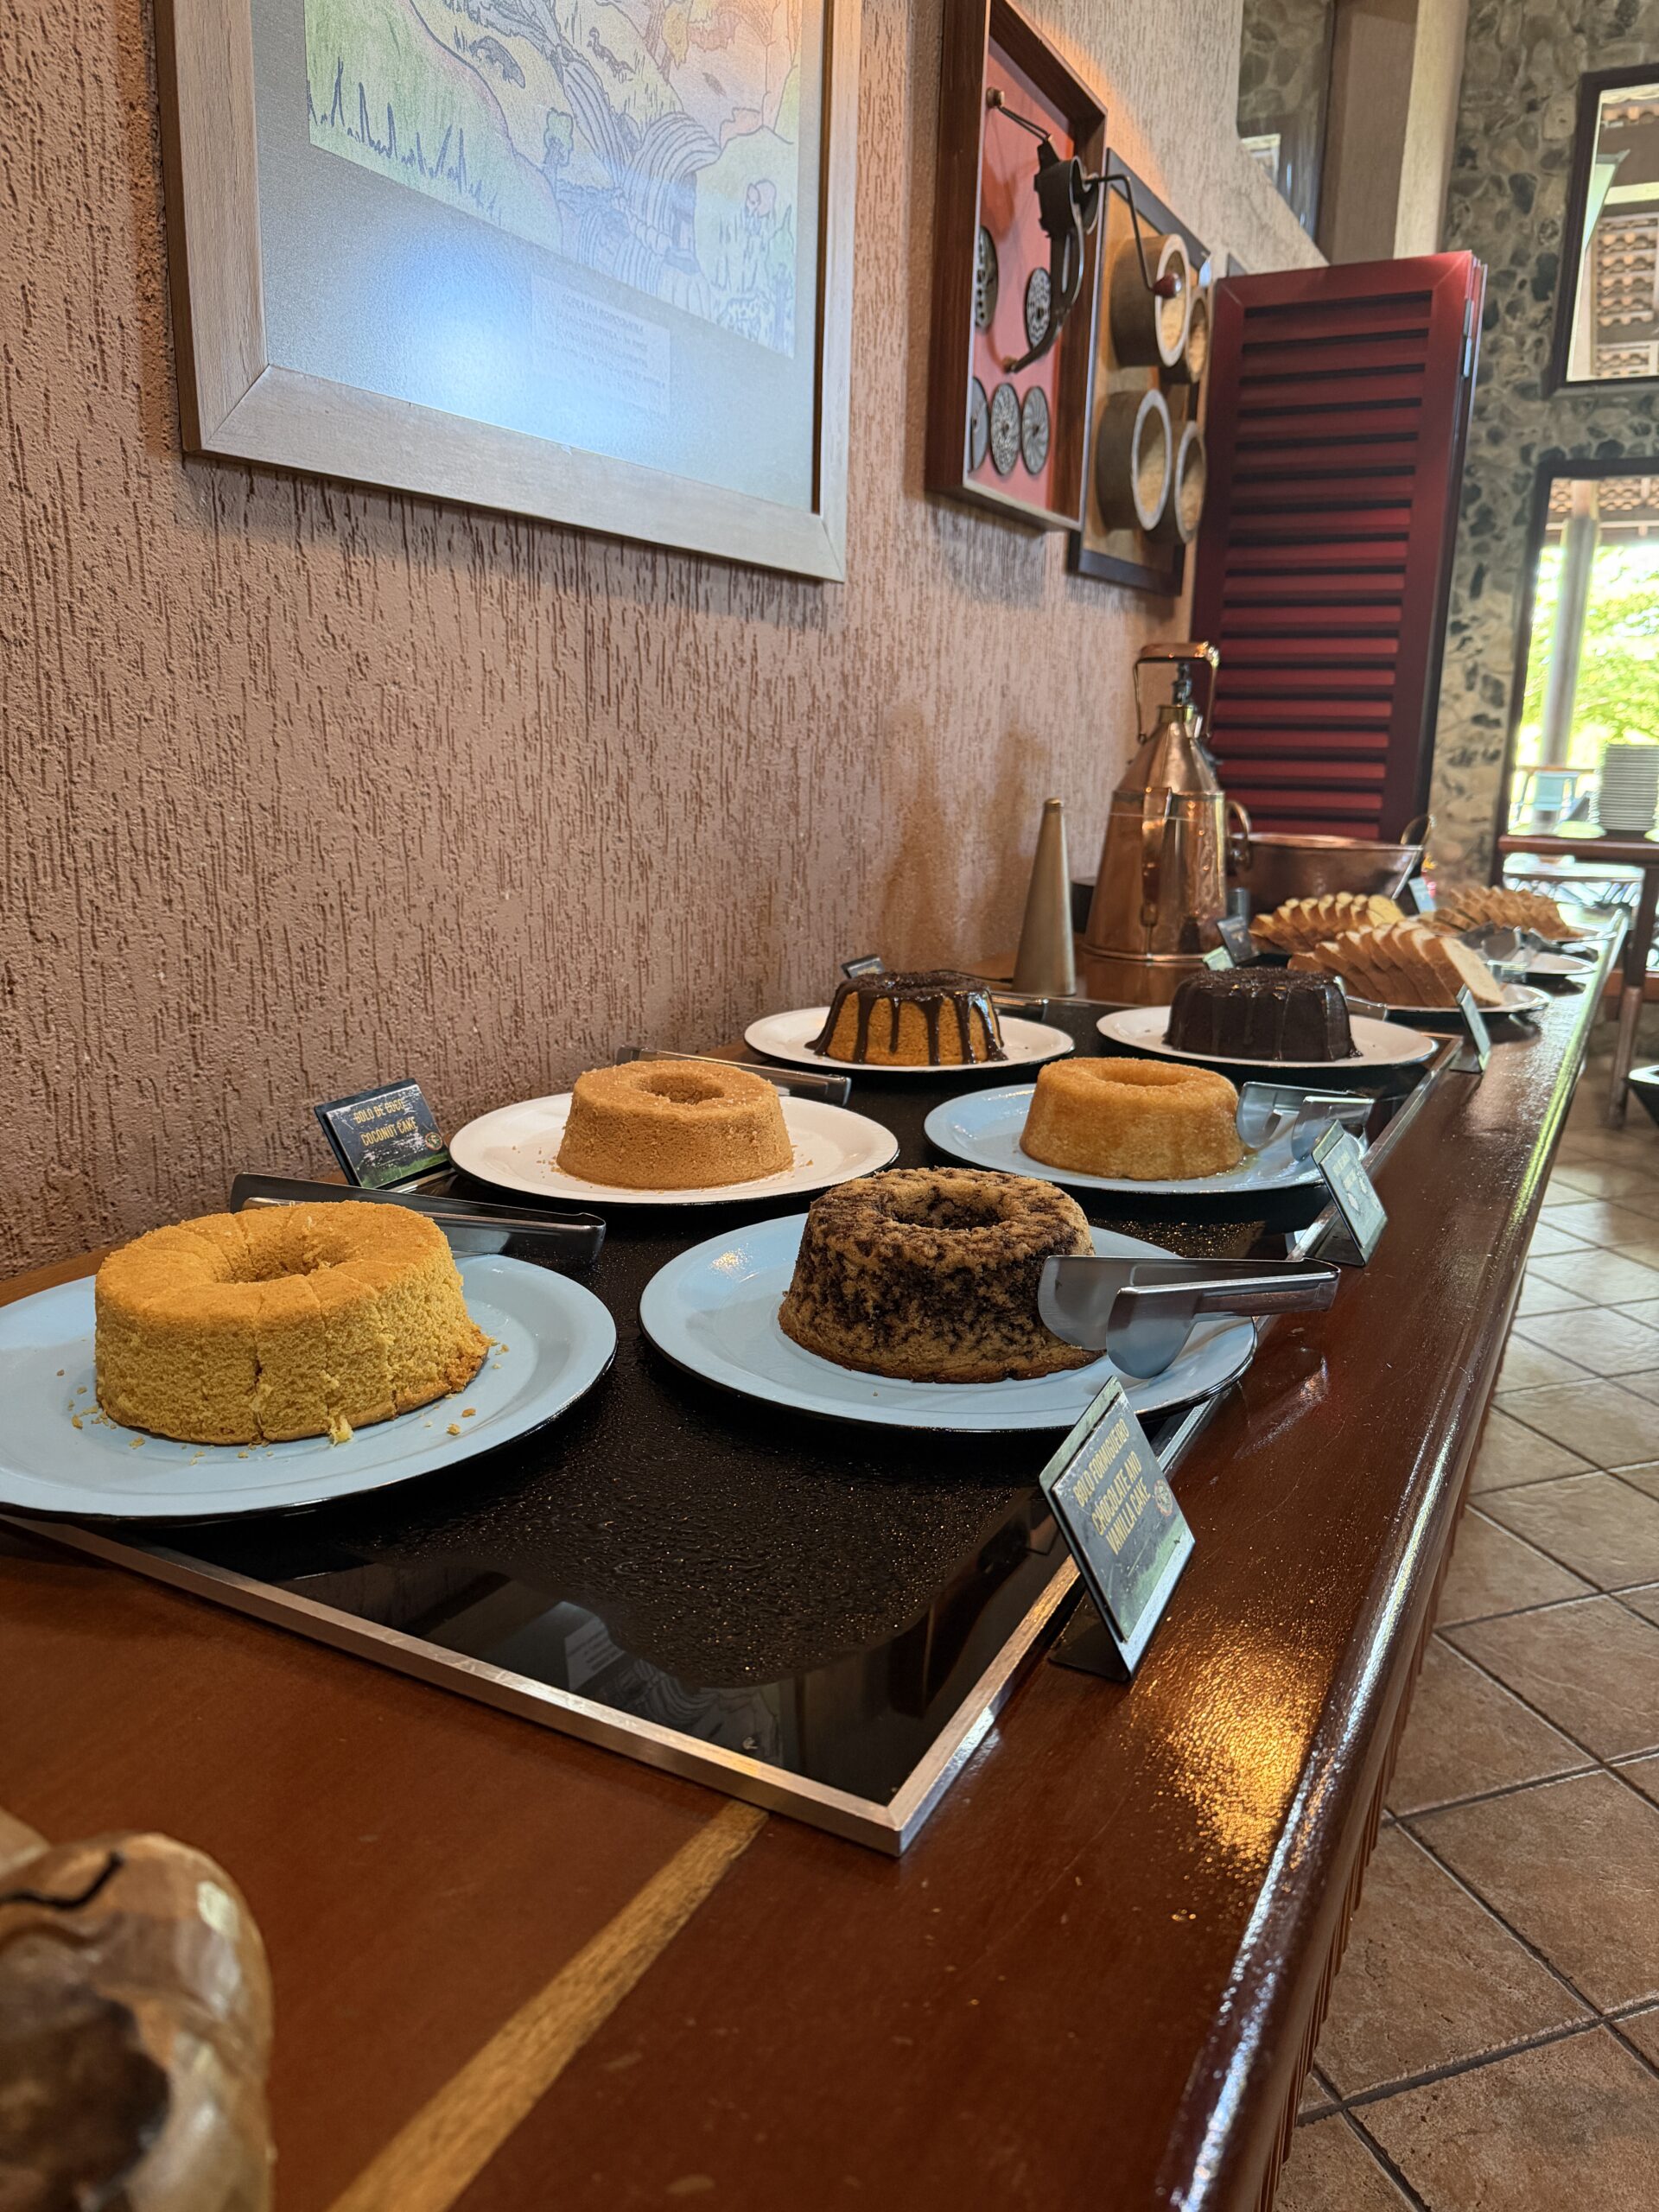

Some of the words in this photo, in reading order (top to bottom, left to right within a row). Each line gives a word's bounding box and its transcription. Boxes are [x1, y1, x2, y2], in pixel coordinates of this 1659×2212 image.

[353, 1108, 374, 1124] BOLO
[372, 1104, 385, 1116] DE
[384, 1098, 405, 1114] COCO
[359, 1123, 398, 1146] COCONUT
[396, 1116, 418, 1134] CAKE
[1072, 1469, 1095, 1509] BOLO
[1088, 1417, 1130, 1484] FORMIGUEIRO
[1090, 1467, 1131, 1536] CHOCOLATE
[1123, 1450, 1142, 1484] AND
[1105, 1500, 1136, 1556] VANILLA
[1128, 1477, 1150, 1516] CAKE
